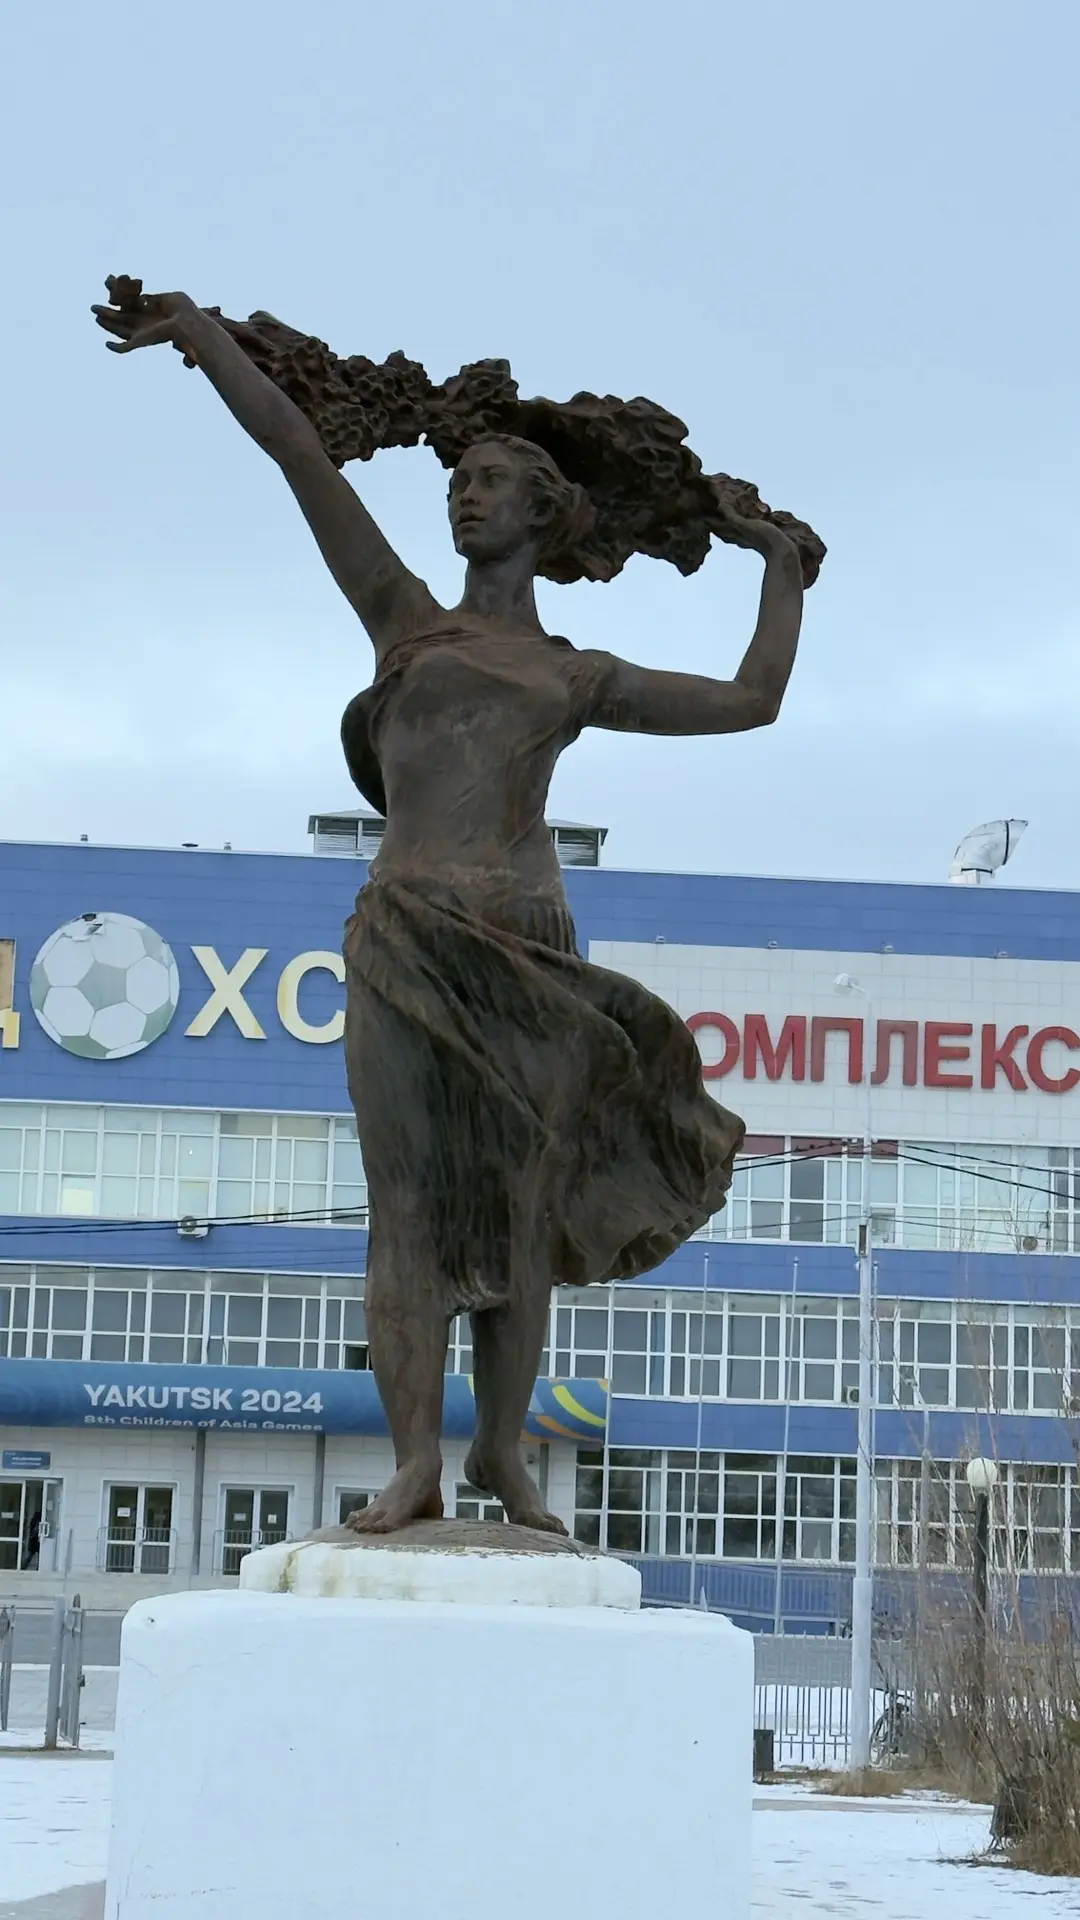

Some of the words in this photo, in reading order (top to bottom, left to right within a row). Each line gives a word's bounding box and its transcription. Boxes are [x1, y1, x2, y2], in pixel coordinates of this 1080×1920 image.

[84, 1384, 233, 1410] YAKUTSK
[241, 1389, 324, 1414] 2024
[84, 1415, 116, 1424] 8th
[120, 1416, 193, 1427] Children
[197, 1419, 217, 1428] of
[220, 1420, 258, 1429] Asia
[262, 1421, 323, 1432] Games
